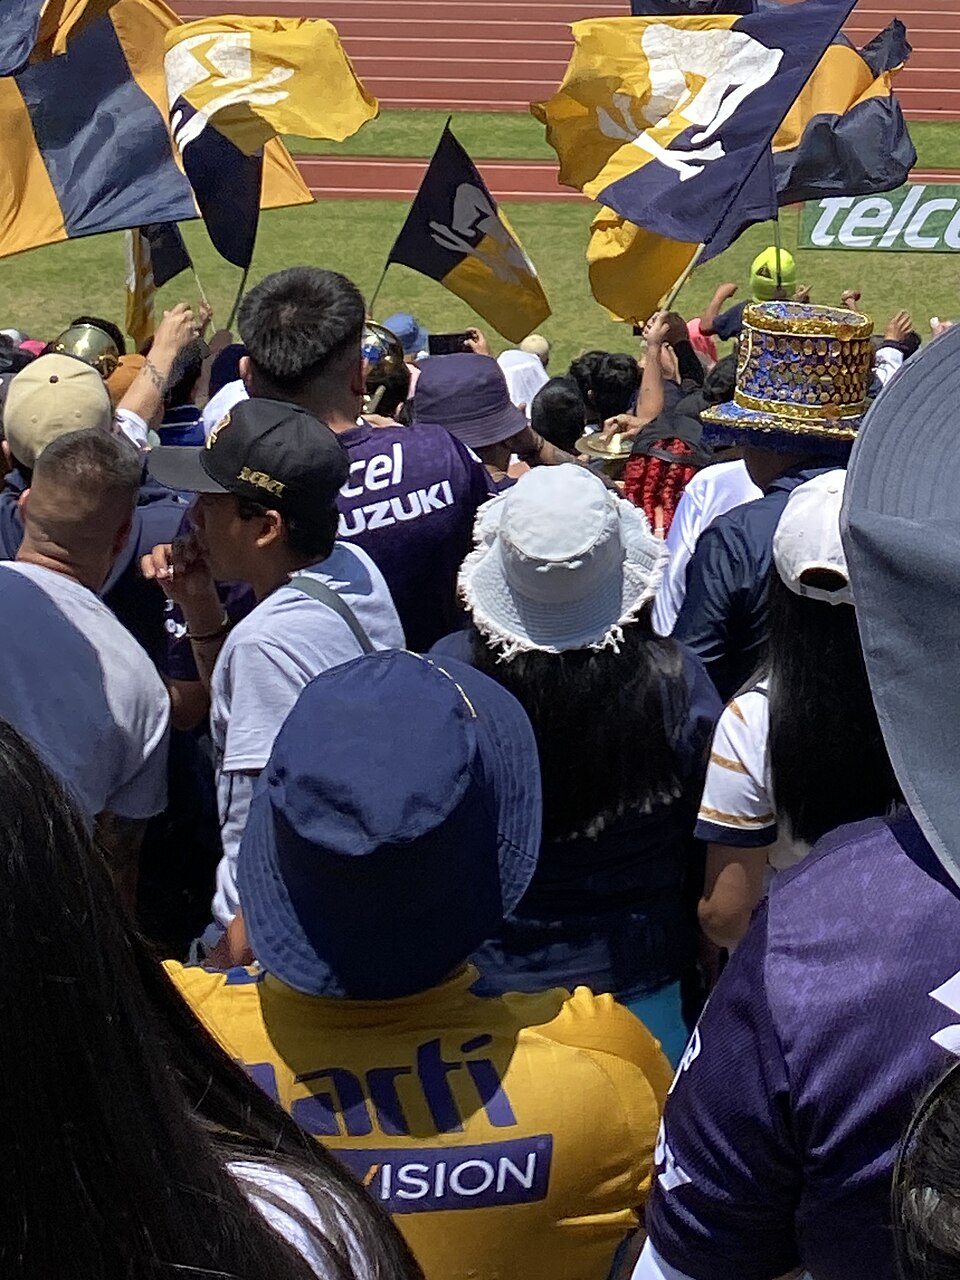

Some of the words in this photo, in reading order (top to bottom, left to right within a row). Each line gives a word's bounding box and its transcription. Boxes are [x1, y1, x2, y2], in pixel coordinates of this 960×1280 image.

[337, 480, 455, 537] UZUKI
[244, 1034, 519, 1137] arti
[361, 1153, 537, 1201] ISION
